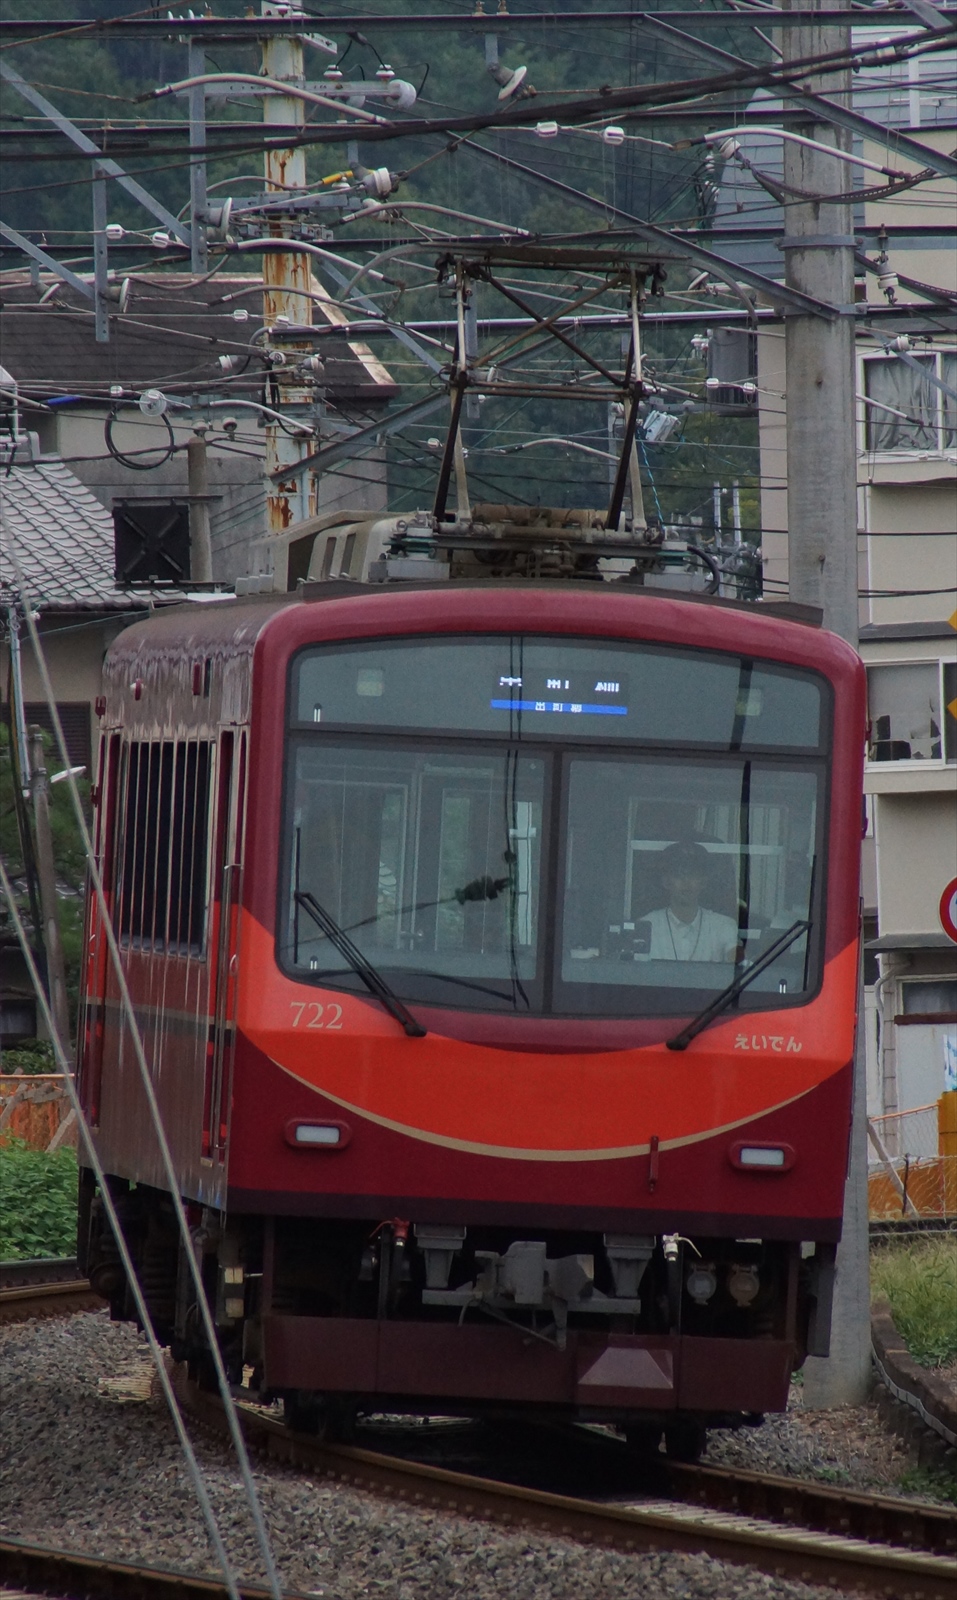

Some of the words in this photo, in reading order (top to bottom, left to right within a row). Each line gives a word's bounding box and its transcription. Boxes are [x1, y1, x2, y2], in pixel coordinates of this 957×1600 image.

[290, 1001, 343, 1029] 722
[734, 1033, 803, 1053] えいでん
